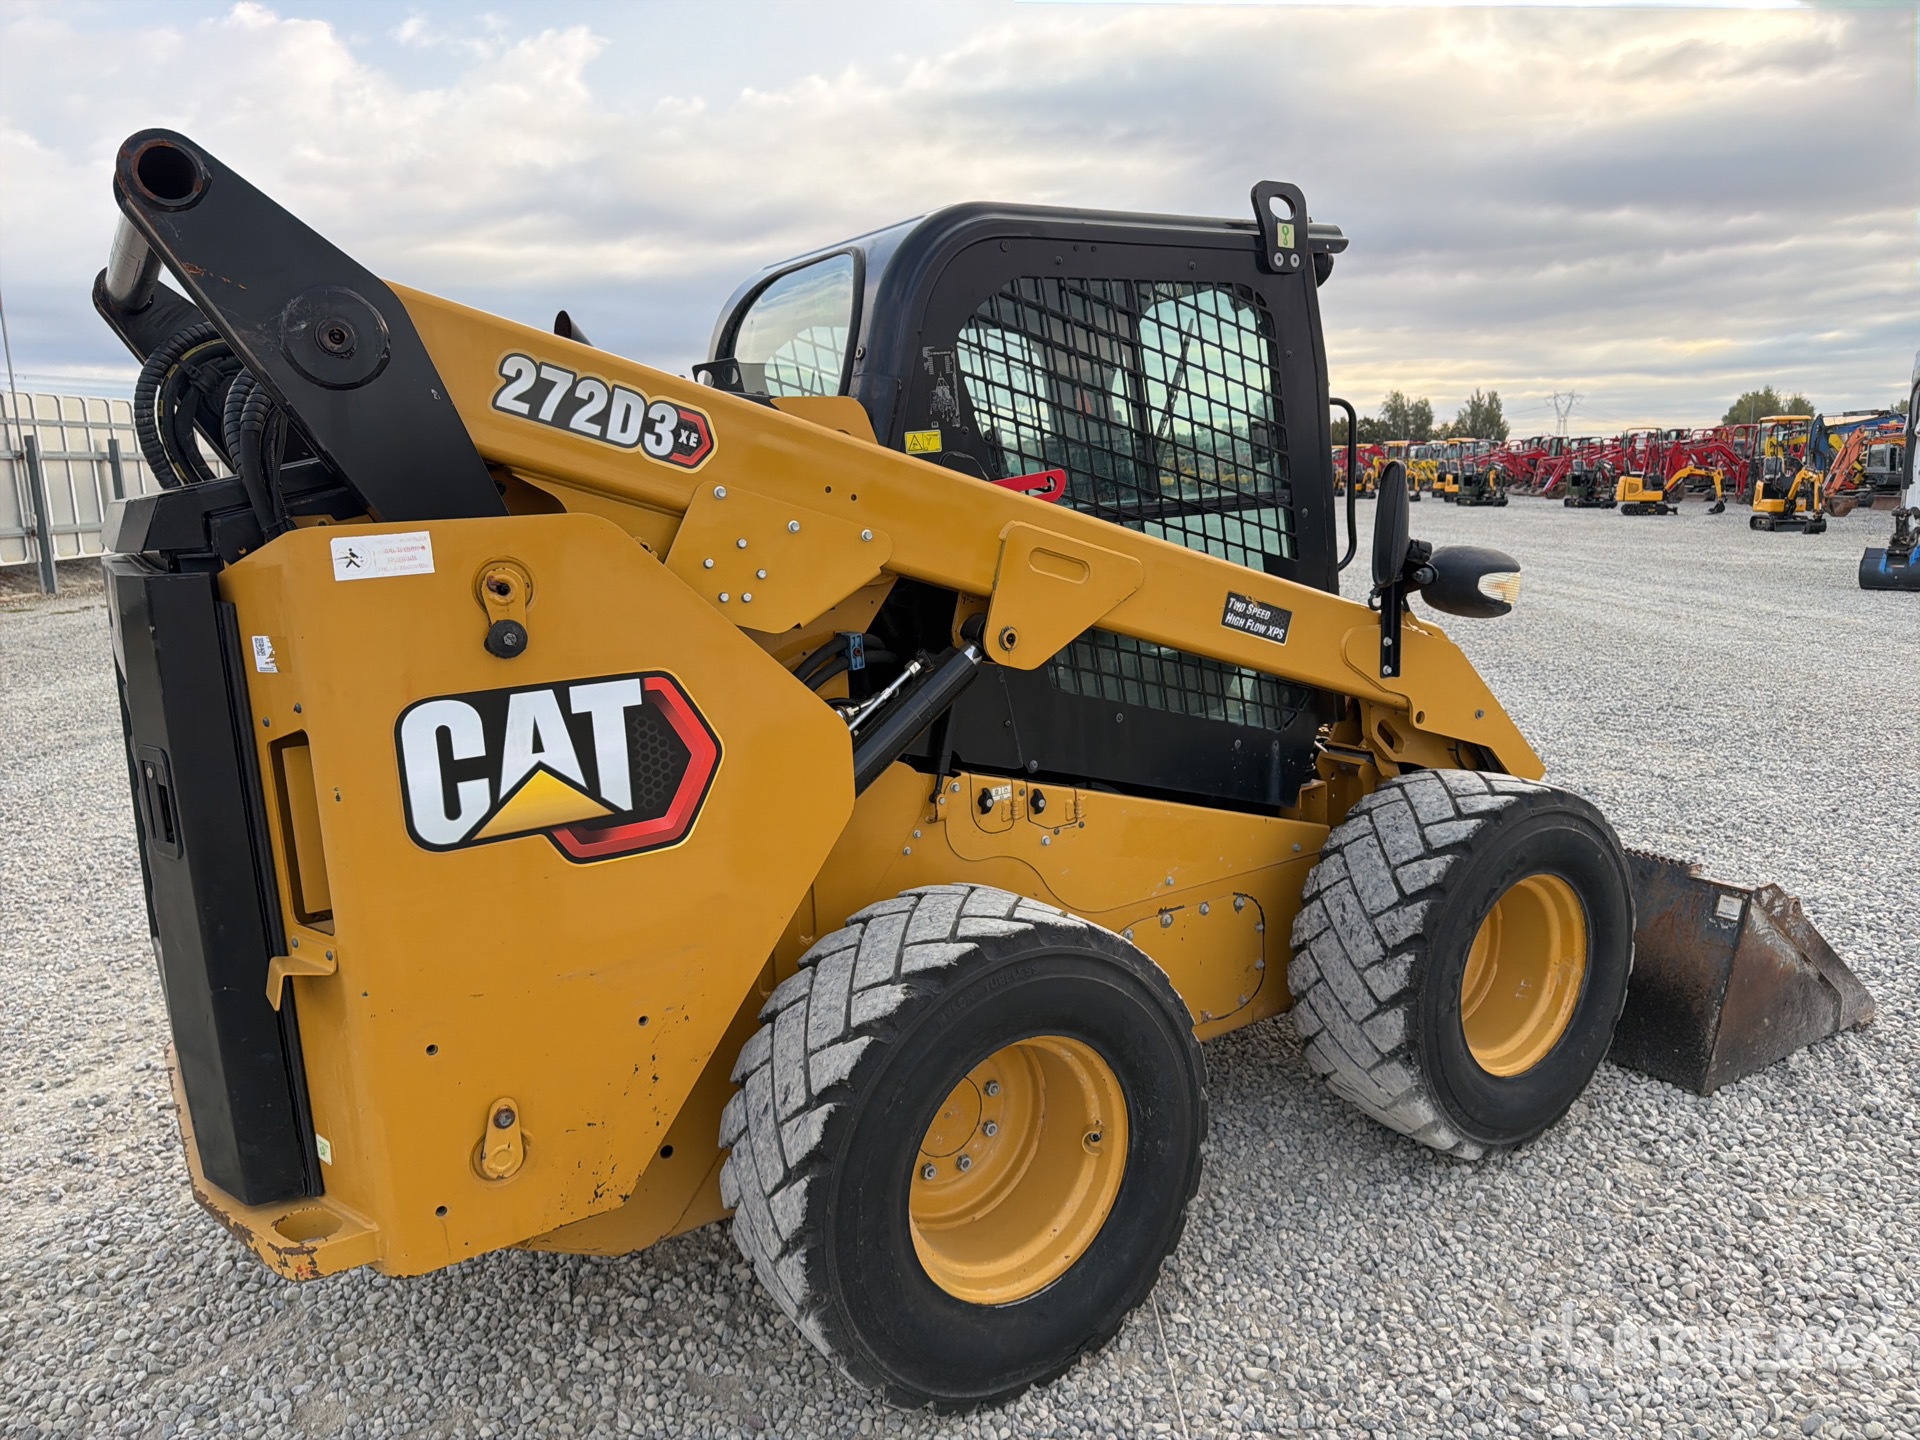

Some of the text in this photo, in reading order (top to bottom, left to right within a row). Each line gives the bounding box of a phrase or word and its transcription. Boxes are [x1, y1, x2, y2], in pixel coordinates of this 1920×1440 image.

[495, 355, 699, 457] 272D3 XE
[1266, 625, 1285, 640] XPS
[401, 678, 643, 845] CAT
